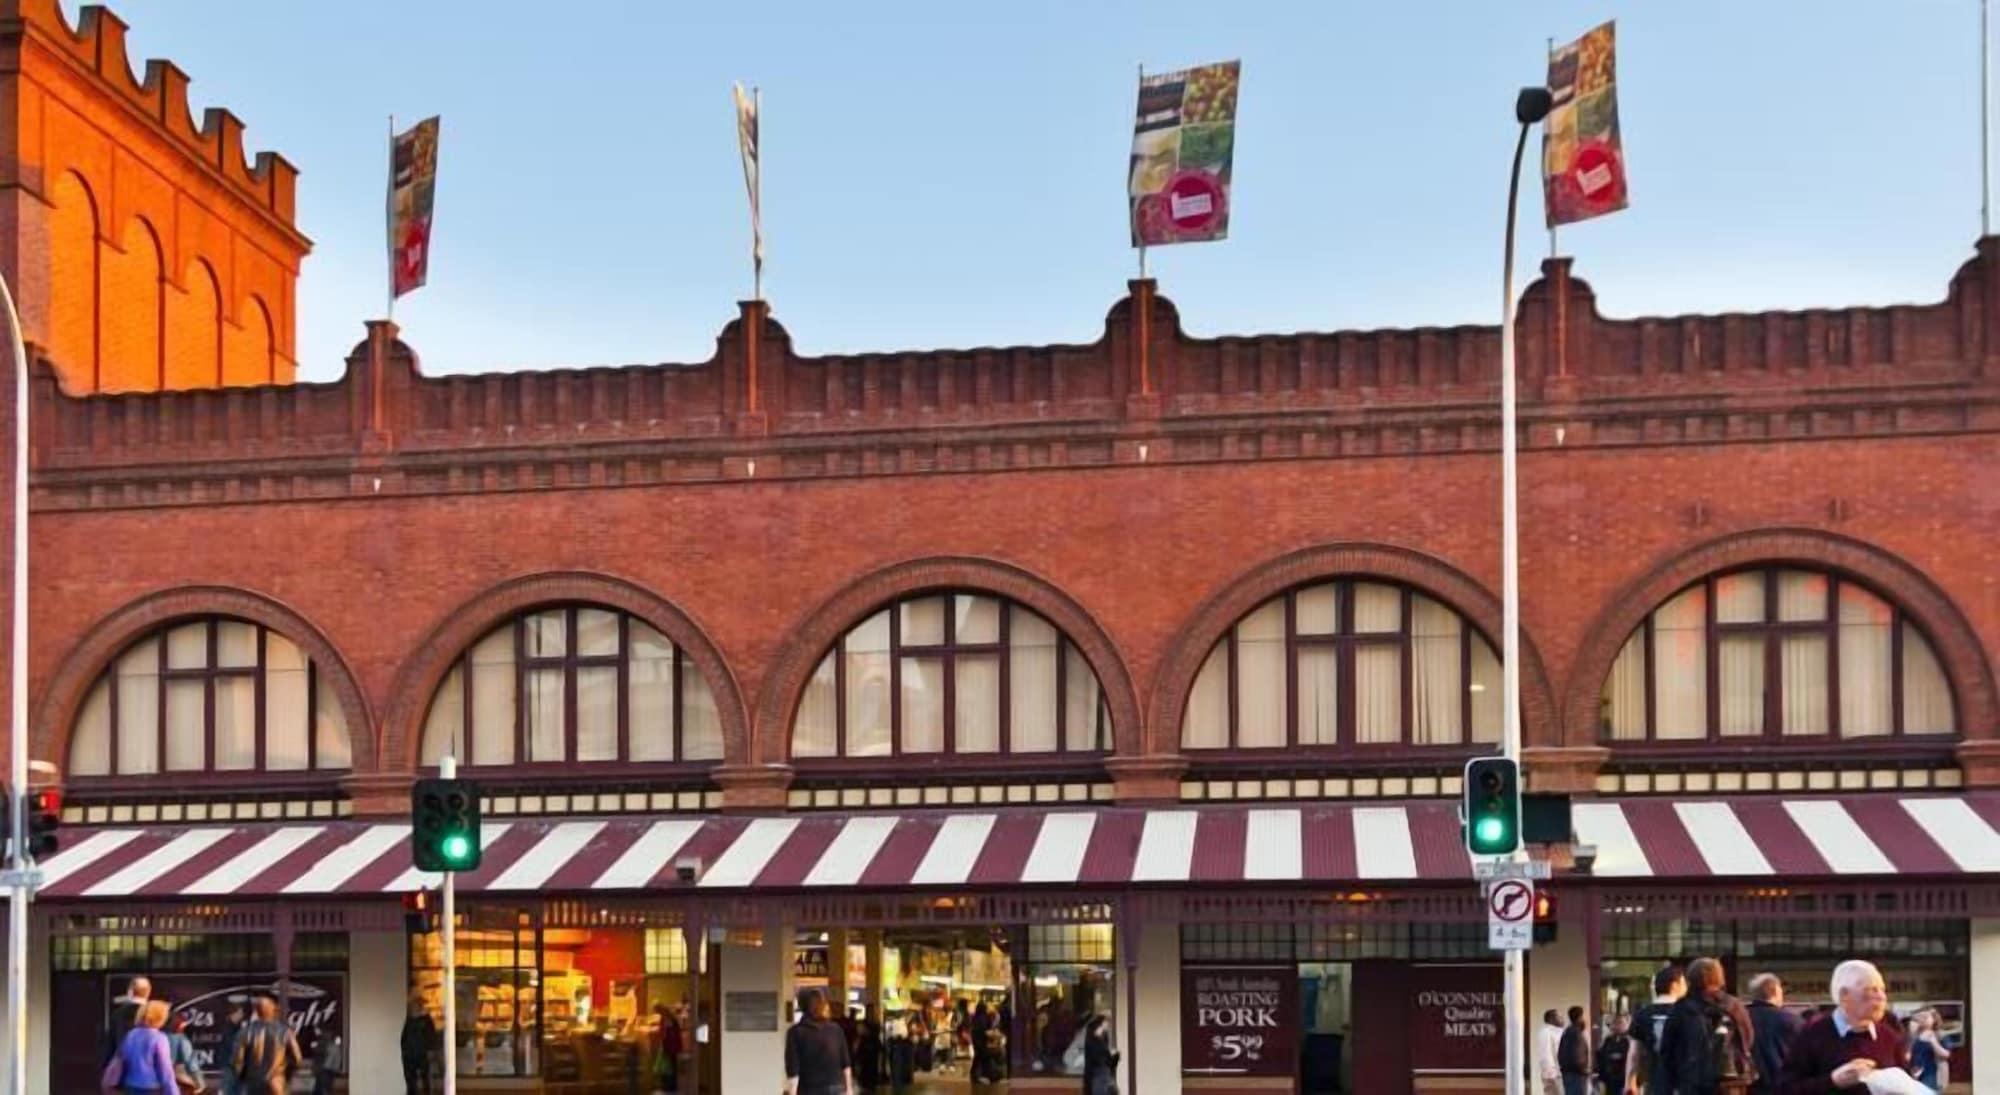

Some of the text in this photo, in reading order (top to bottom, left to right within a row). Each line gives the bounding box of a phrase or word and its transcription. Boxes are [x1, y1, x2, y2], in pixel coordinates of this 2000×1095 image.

[1197, 992, 1279, 1006] ROASTING
[1418, 990, 1504, 1007] O'CONNEL
[1198, 1007, 1278, 1027] PORK
[1444, 1022, 1497, 1036] MEATS
